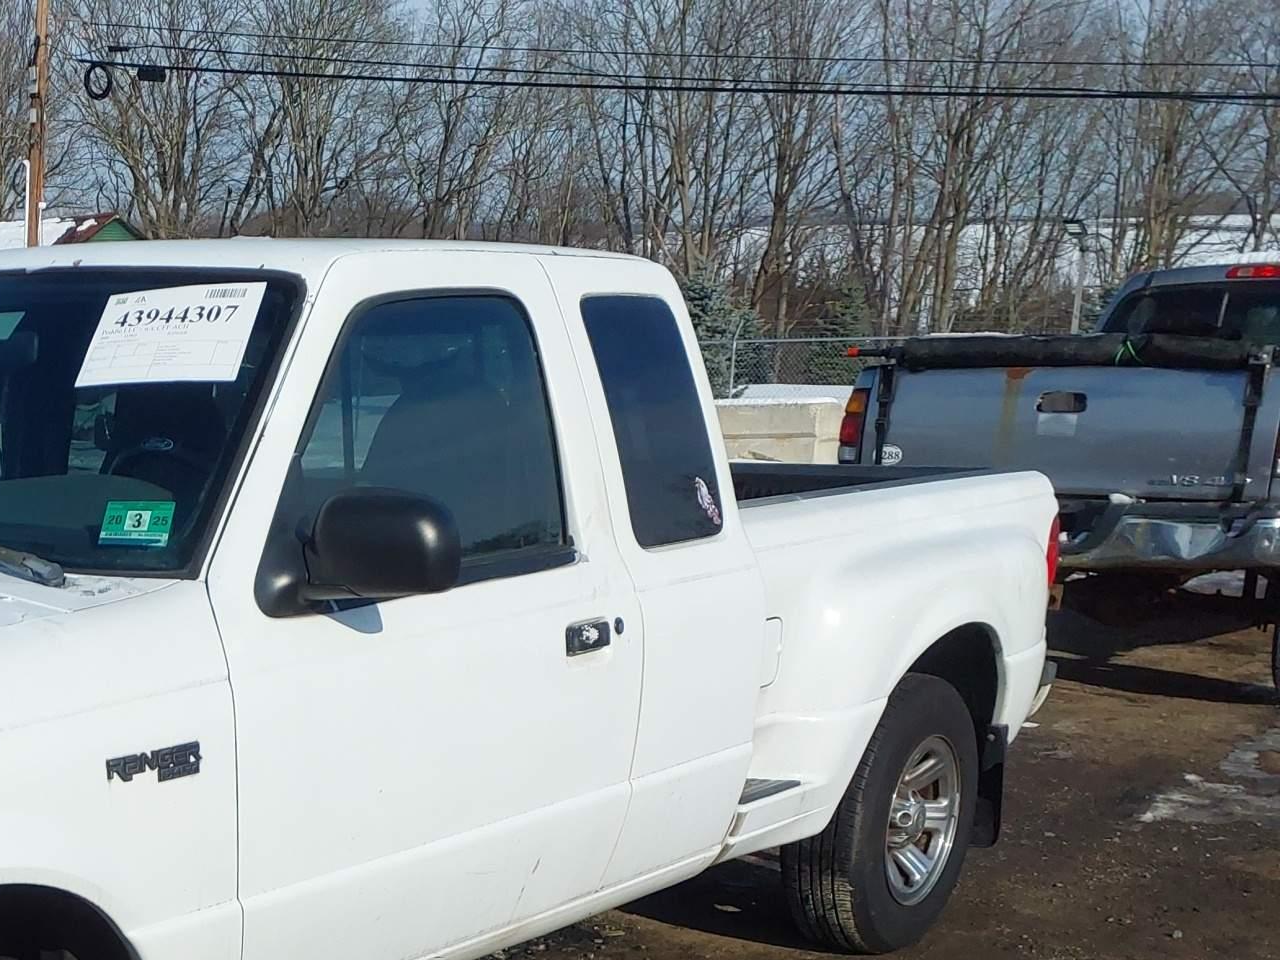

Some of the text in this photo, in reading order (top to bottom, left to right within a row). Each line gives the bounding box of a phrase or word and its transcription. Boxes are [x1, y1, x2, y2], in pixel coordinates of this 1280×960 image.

[115, 304, 240, 328] 43944307
[107, 512, 169, 529] 20 3 25
[106, 740, 203, 783] RANGER
